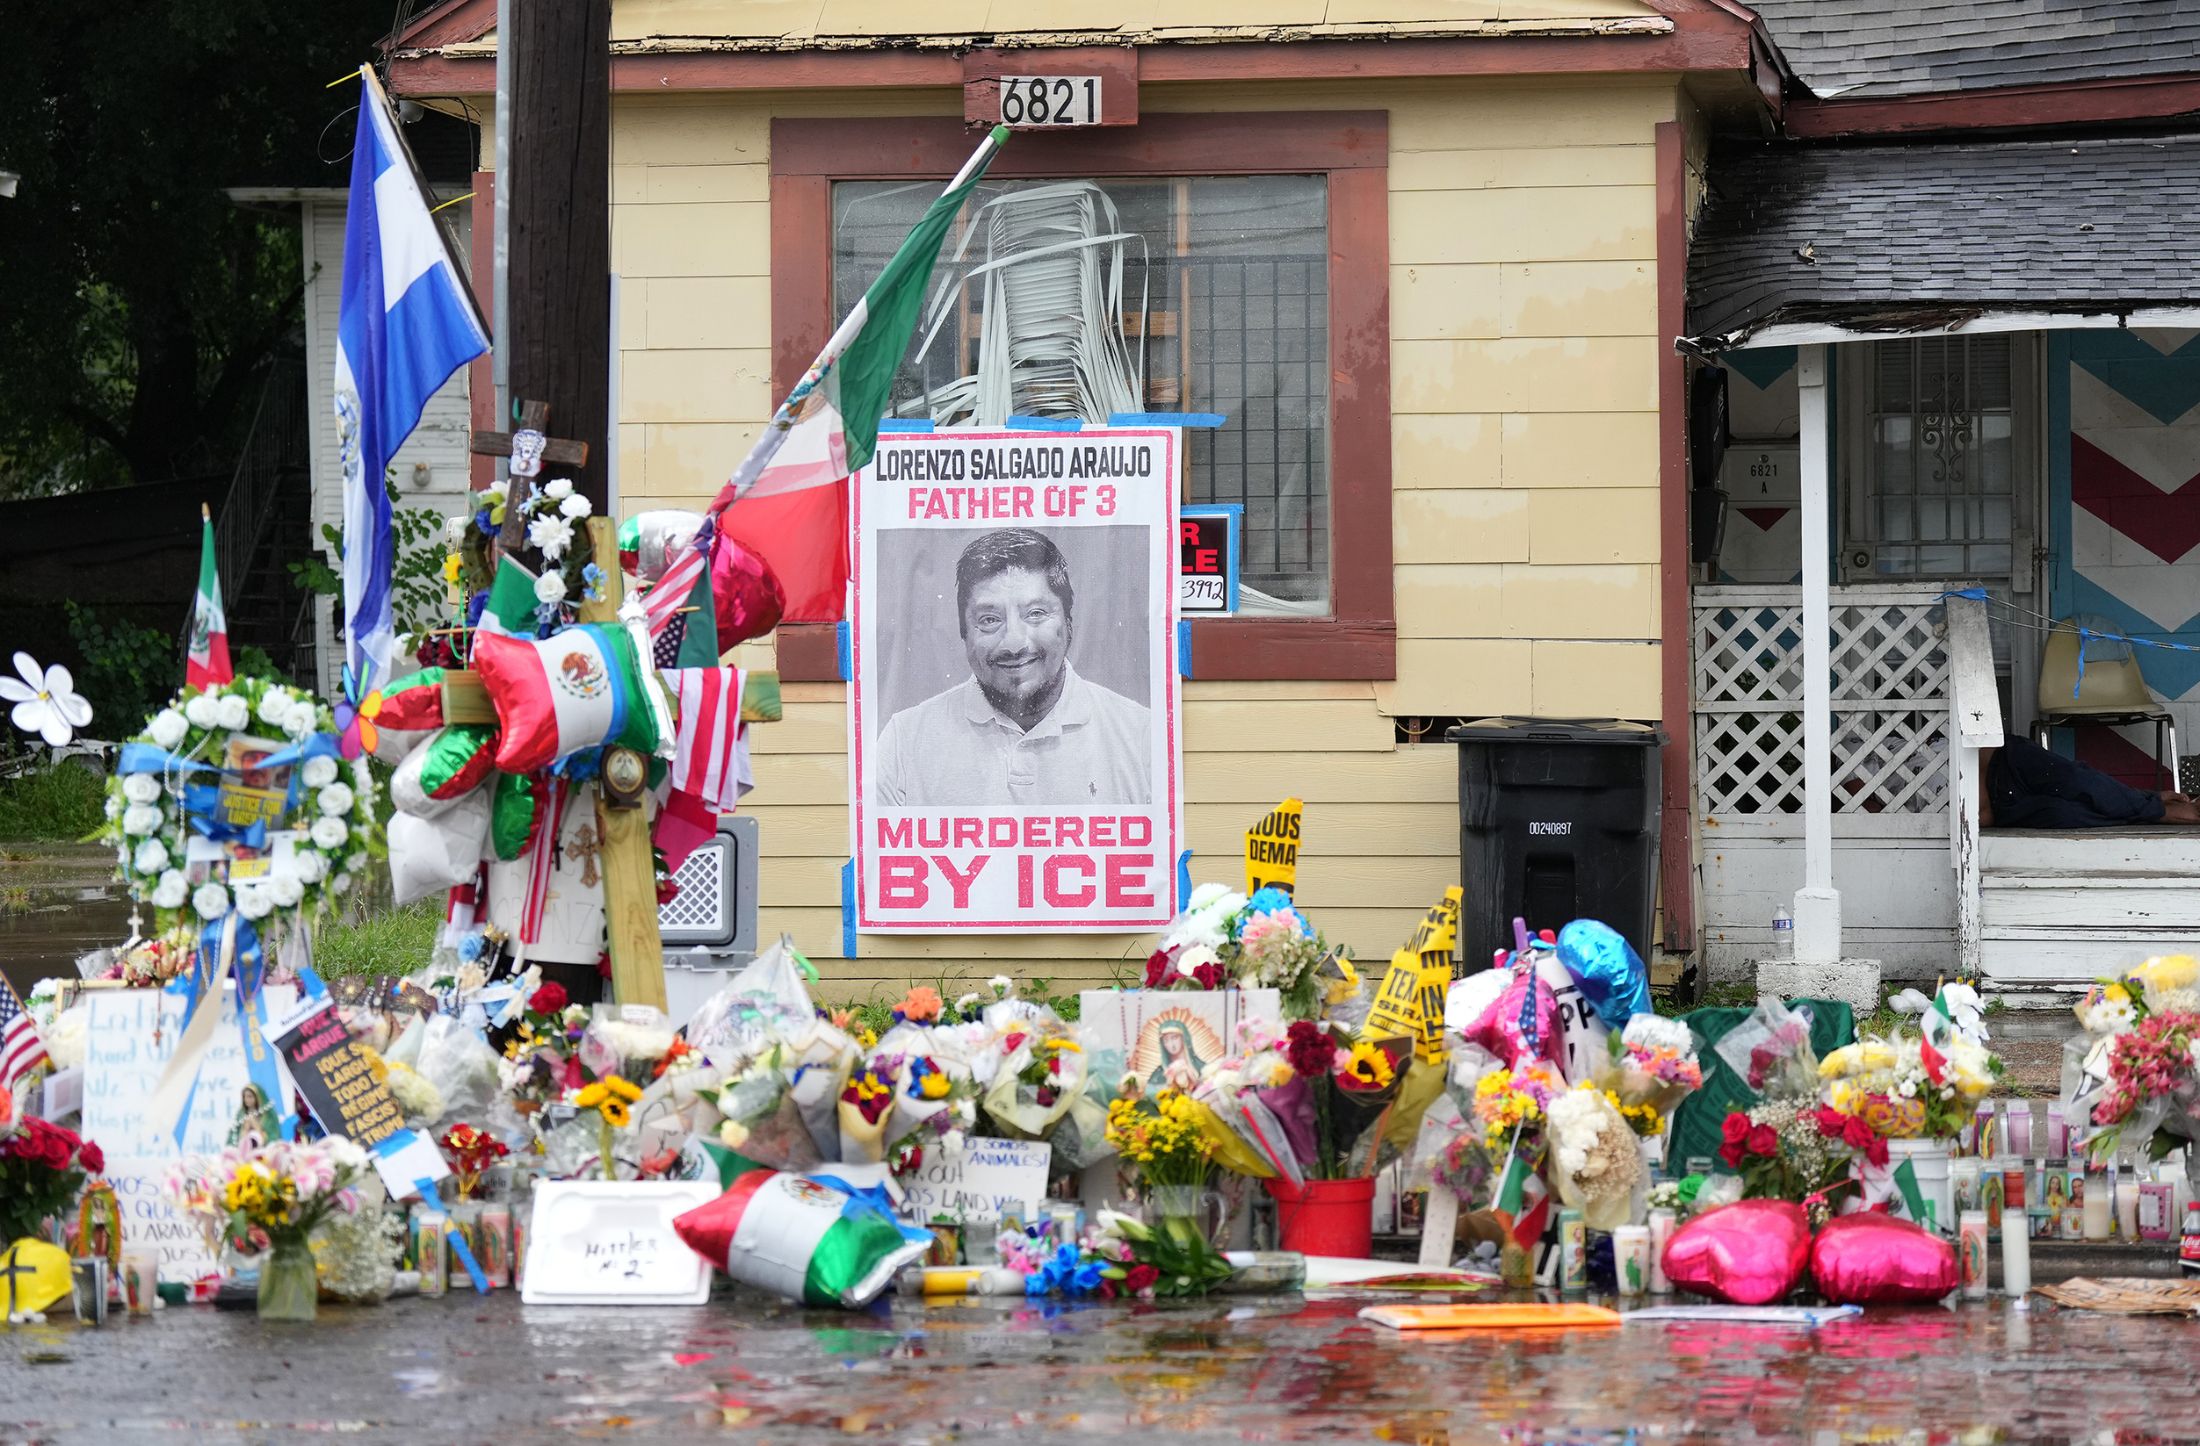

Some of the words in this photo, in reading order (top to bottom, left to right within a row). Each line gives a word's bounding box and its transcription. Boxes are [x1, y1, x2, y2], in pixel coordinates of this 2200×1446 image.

[1002, 78, 1094, 123] 6821
[876, 449, 965, 481] LORENZO
[970, 447, 1064, 480] SALGADO
[1069, 446, 1151, 478] ARAUJO
[1750, 464, 1777, 477] 6821
[908, 486, 1034, 519] FATHER
[1044, 485, 1088, 517] OF
[1096, 485, 1117, 516] 3
[1761, 481, 1768, 494] A
[877, 816, 1153, 848] MURDERED
[1529, 821, 1572, 835] 00240897
[879, 854, 991, 909] BY
[1017, 854, 1154, 908] ICE
[293, 1026, 348, 1062] LARGUE
[323, 1054, 374, 1090] LARGU
[332, 1075, 371, 1104] TODO
[942, 1189, 989, 1212] LAND
